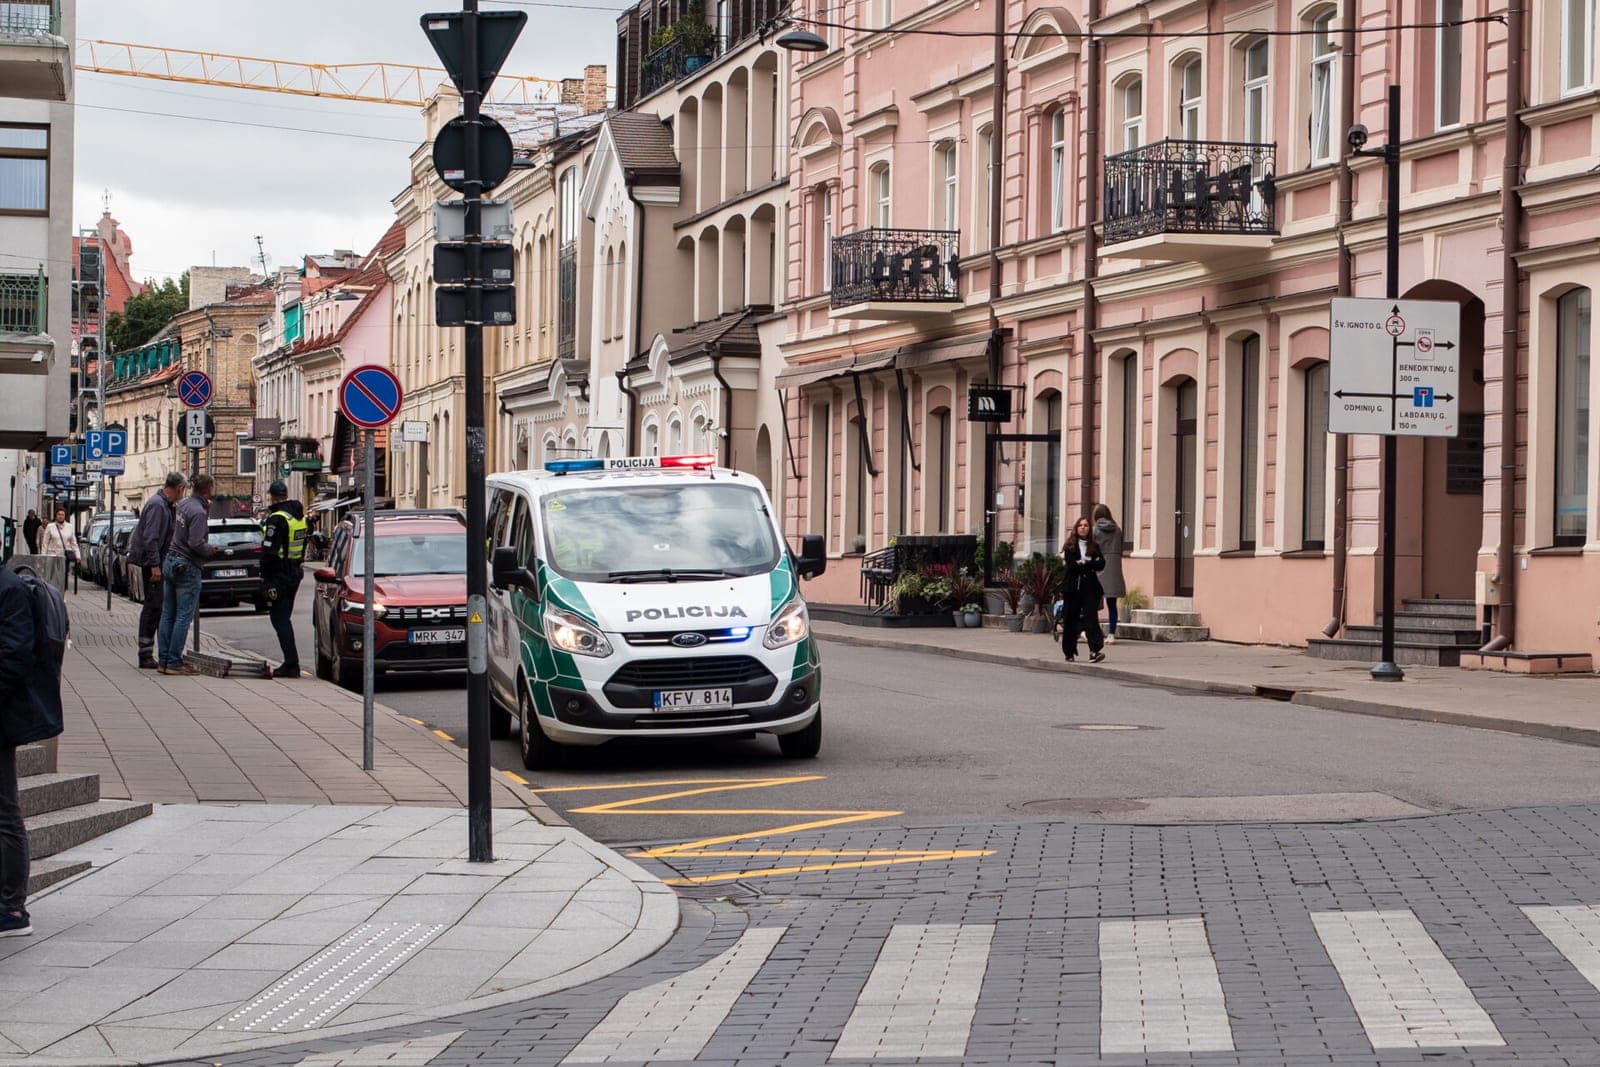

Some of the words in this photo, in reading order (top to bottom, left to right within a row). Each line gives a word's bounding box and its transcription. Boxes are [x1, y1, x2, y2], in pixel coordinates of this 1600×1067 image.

[1334, 319, 1346, 329] ŠV.
[1347, 321, 1374, 330] IGNOTO
[1375, 322, 1384, 330] G.
[1399, 364, 1447, 374] BENEDIKTINIŲ
[1343, 404, 1376, 414] ODMINIŲ
[1399, 411, 1438, 421] LABDARIŲ
[1439, 412, 1448, 420] G.
[189, 426, 203, 436] 25
[1398, 422, 1410, 430] 150
[91, 432, 101, 448] P
[108, 433, 122, 453] P
[57, 447, 69, 463] P
[610, 458, 655, 469] POLICIJA
[626, 605, 748, 623] POLICIJA
[415, 630, 438, 641] MRK
[444, 630, 464, 640] 347
[662, 691, 694, 706] KFV
[703, 689, 730, 704] 814
